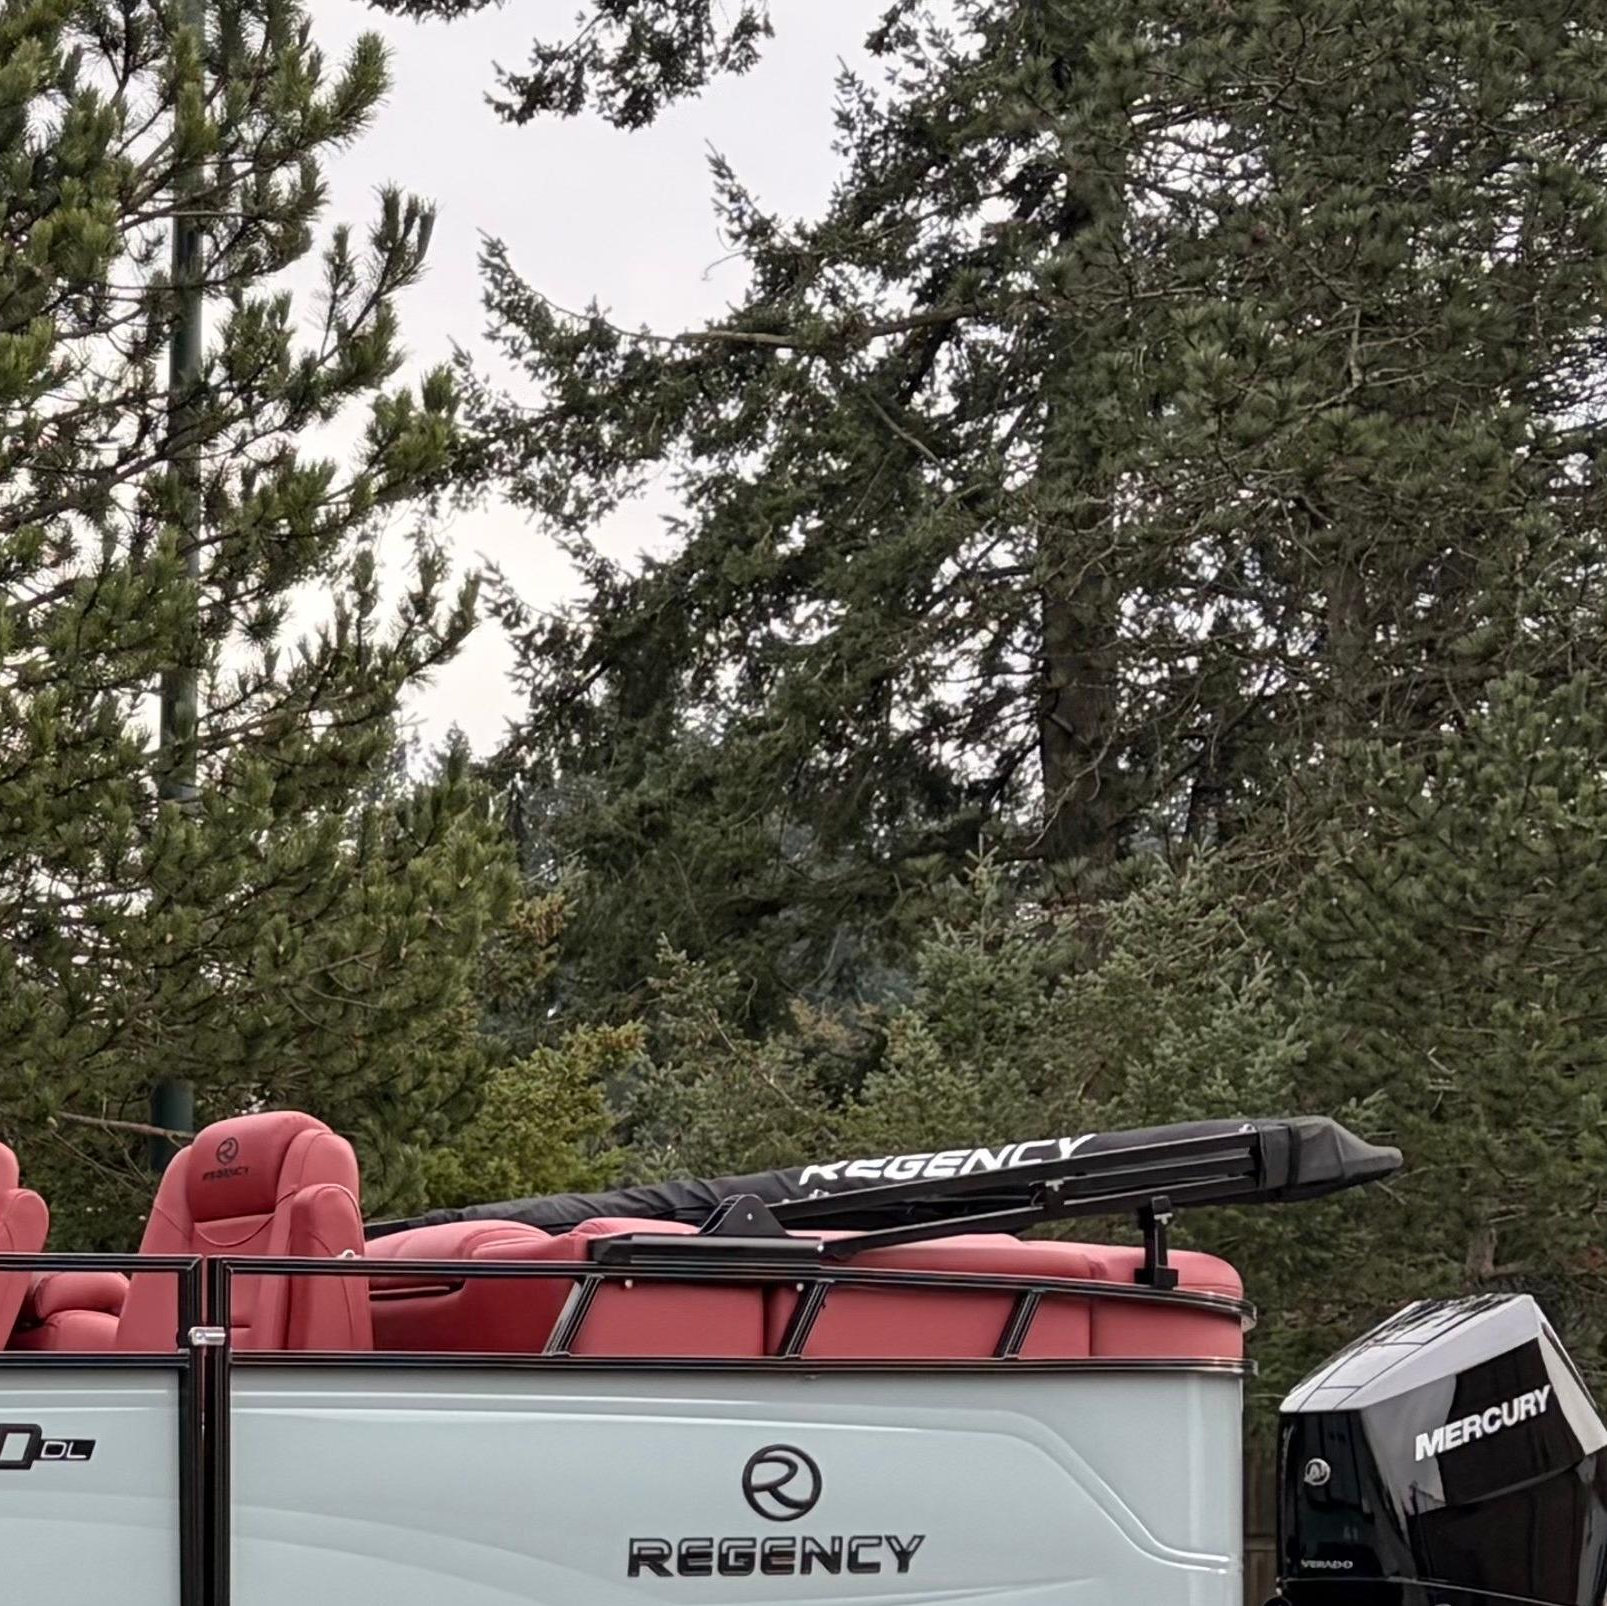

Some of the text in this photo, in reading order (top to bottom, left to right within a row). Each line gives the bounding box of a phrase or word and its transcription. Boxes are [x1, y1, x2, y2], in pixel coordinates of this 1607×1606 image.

[1414, 1384, 1552, 1462] MERCURY
[627, 1534, 926, 1578] REGENCY
[1300, 1558, 1354, 1570] VERADO
